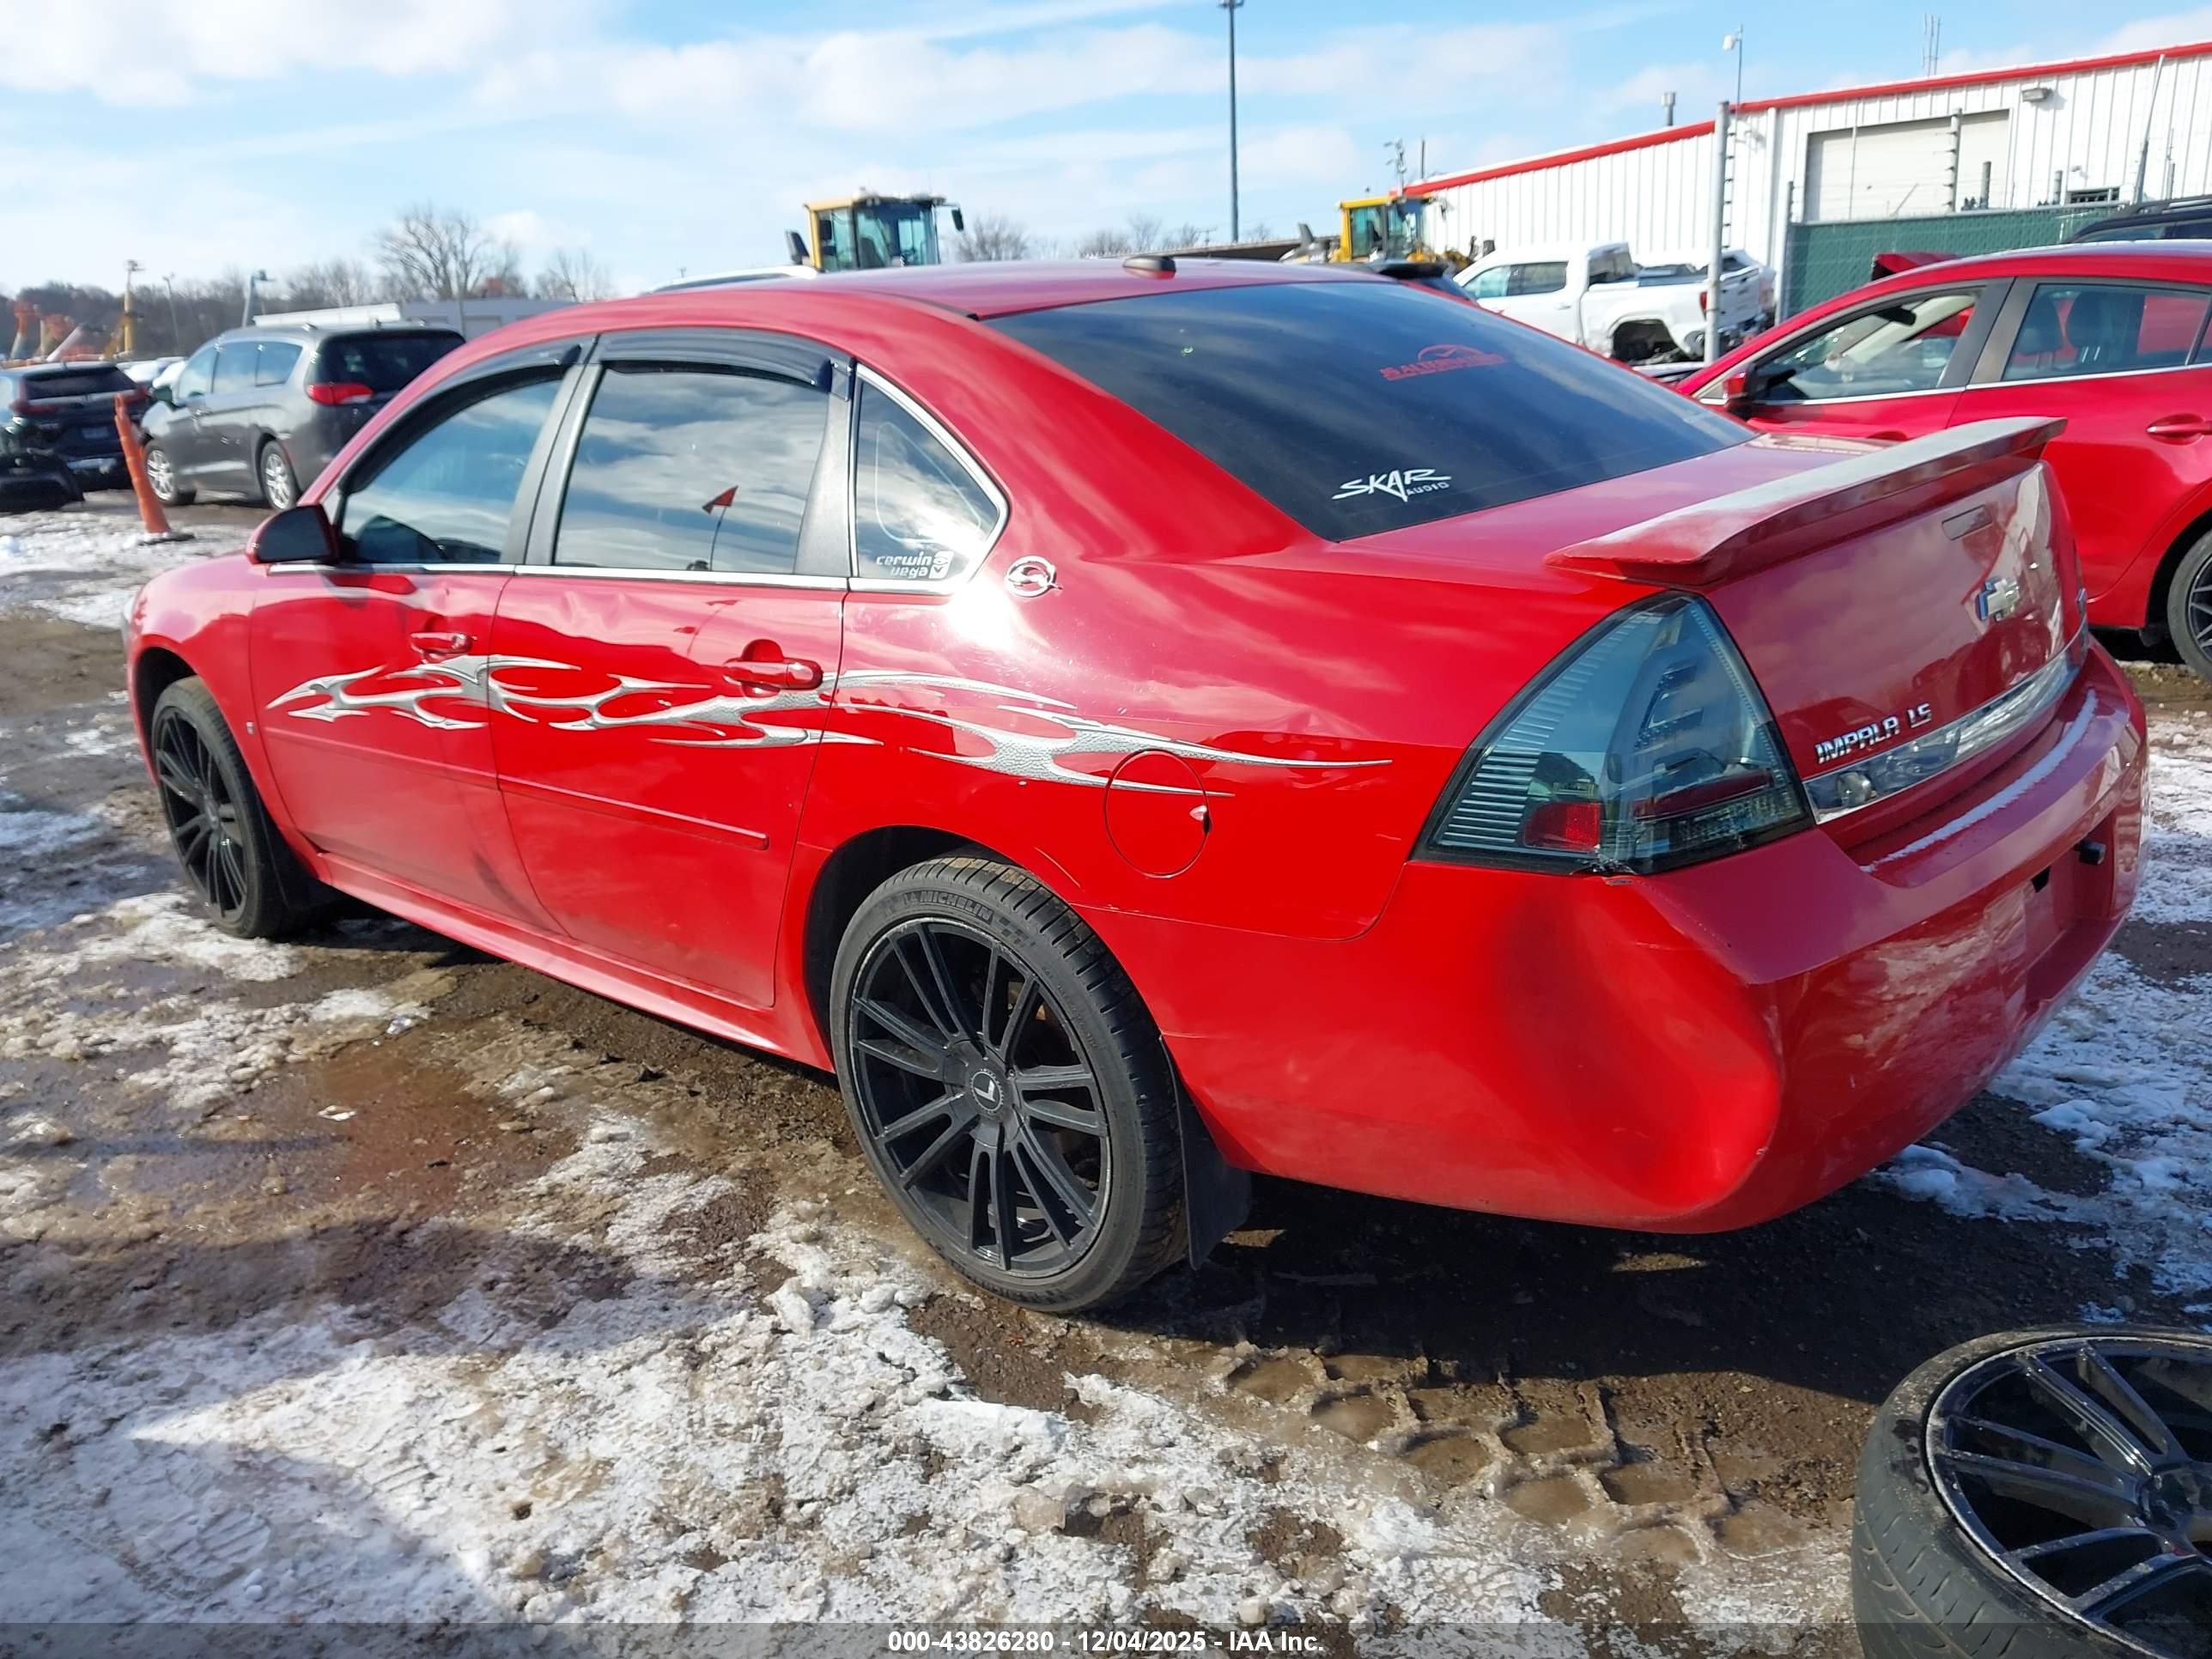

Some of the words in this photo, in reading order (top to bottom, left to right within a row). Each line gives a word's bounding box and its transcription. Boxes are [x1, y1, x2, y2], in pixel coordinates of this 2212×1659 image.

[1331, 469, 1452, 502] SKAR
[1407, 482, 1450, 496] AUDIO
[876, 550, 933, 566] cerwin
[1814, 715, 1900, 764] IMPALA
[1907, 702, 1933, 728] LS
[920, 889, 994, 925] MICHELIN
